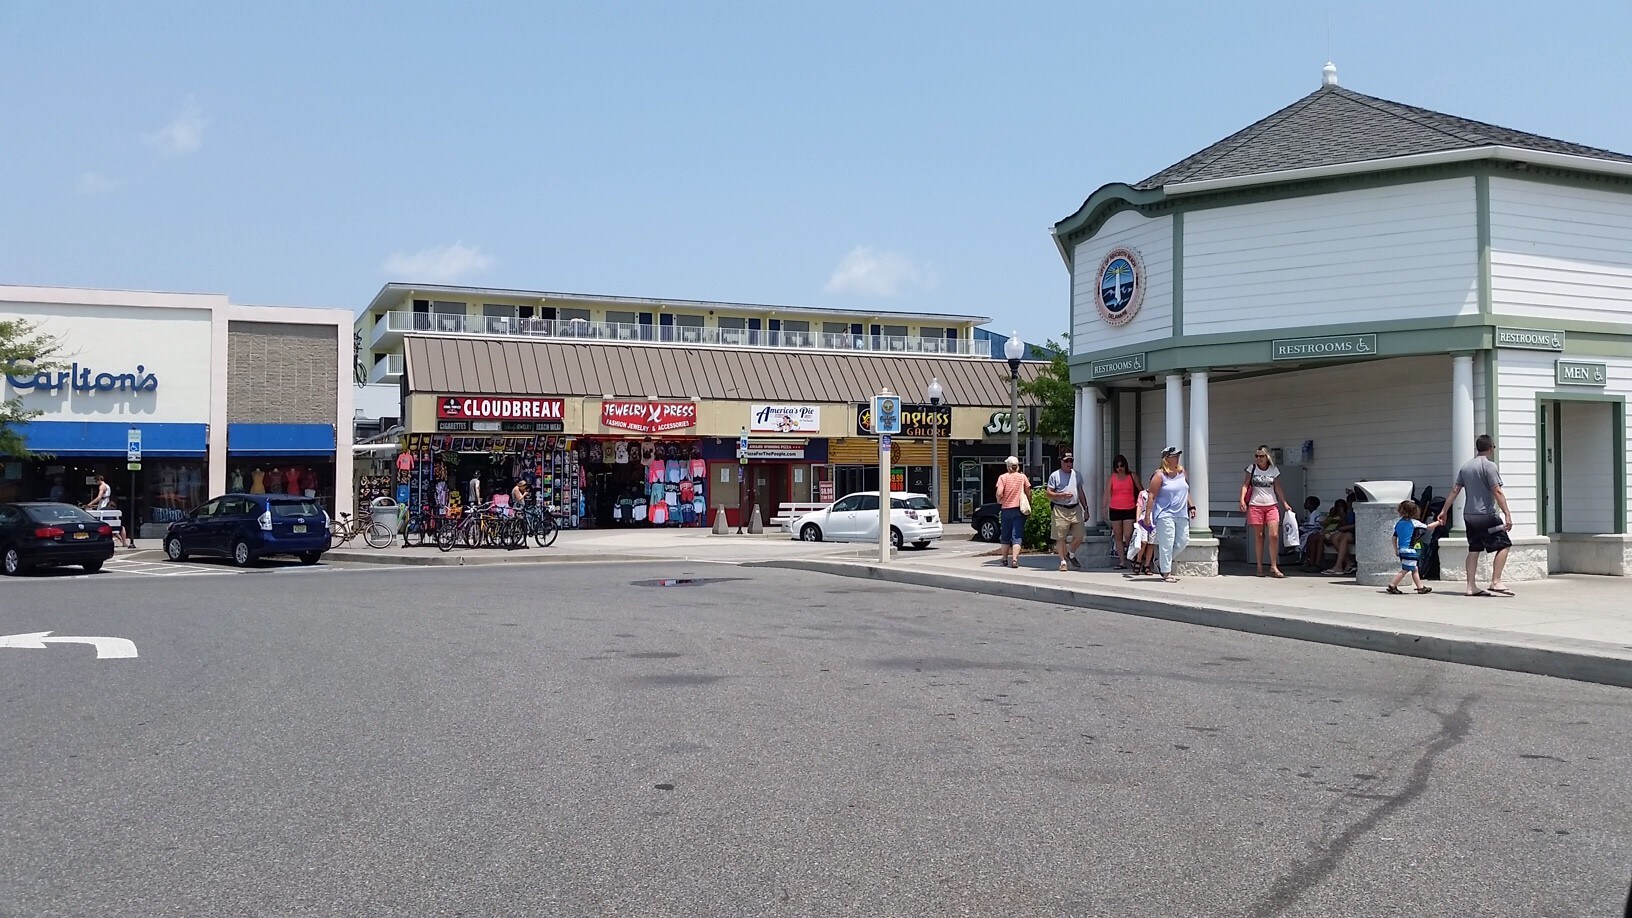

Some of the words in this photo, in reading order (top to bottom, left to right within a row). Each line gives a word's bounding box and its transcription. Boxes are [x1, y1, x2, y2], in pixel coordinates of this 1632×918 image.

[1500, 332, 1550, 344] RESTROOMS
[1279, 341, 1352, 355] RESTROOMS
[1094, 360, 1132, 374] RESTROOMS
[1564, 367, 1589, 379] MEN
[5, 357, 158, 392] Carlton's
[463, 399, 561, 418] CLOUDBREAK
[603, 403, 647, 418] JEWELRY
[756, 406, 798, 424] America's
[799, 407, 815, 419] Pie
[901, 407, 949, 428] nglass
[440, 422, 466, 430] CIGARETTES
[606, 419, 627, 428] FASHION
[627, 422, 649, 432] JEWELRY
[658, 420, 690, 431] ACCESSORIES
[906, 428, 947, 437] GALORE
